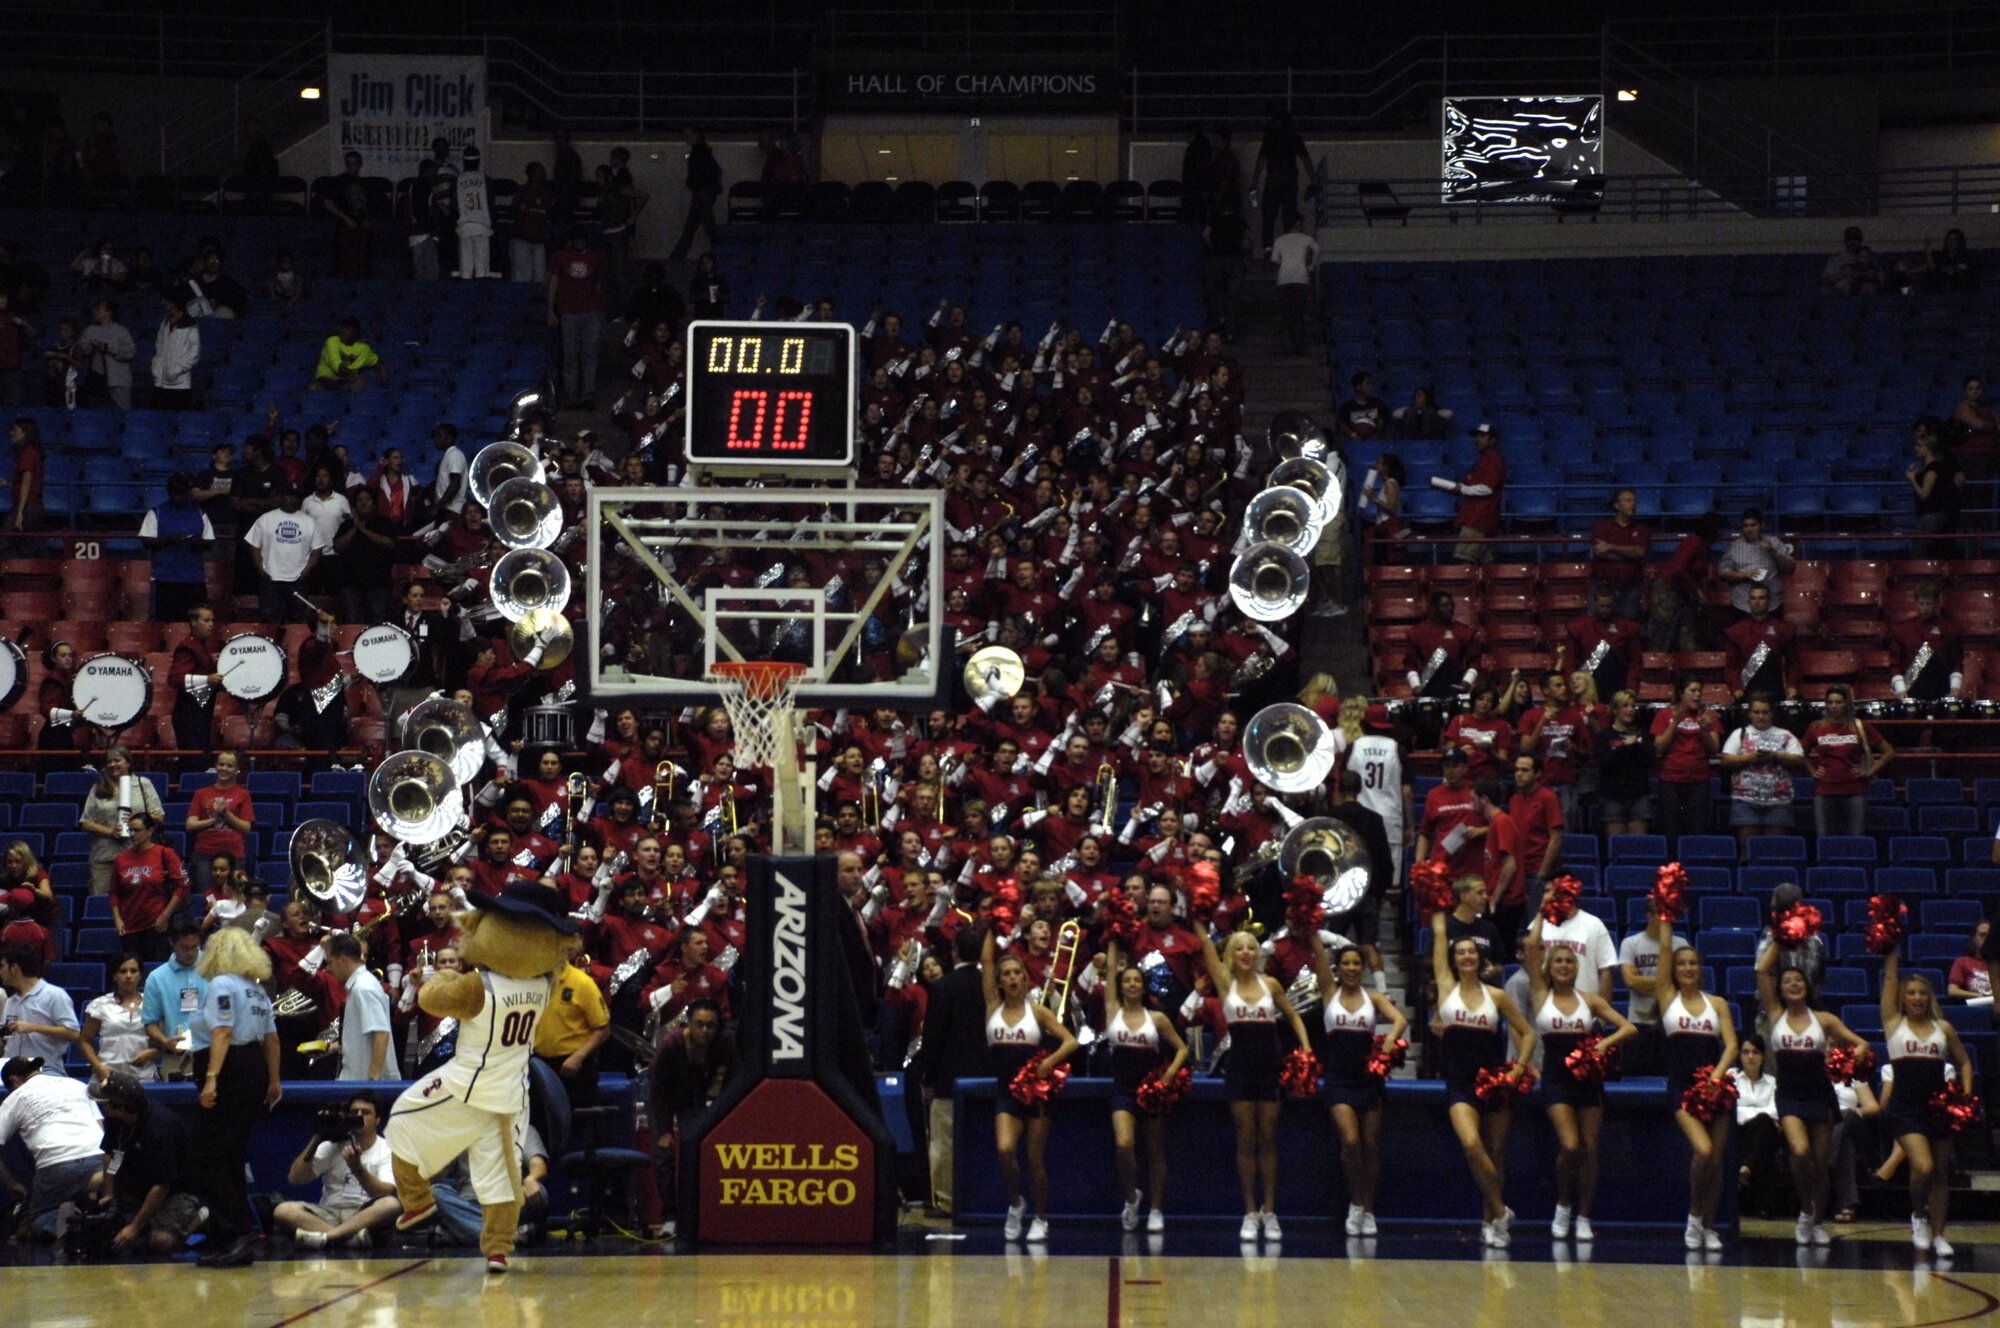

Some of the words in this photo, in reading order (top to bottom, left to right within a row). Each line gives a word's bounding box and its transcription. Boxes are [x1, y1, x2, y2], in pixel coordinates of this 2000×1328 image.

[341, 73, 394, 117] Jim
[405, 73, 474, 118] Click
[848, 75, 907, 94] HALL
[917, 75, 945, 94] OF
[956, 75, 1097, 94] CHAMPIONS
[466, 192, 481, 211] 31
[708, 337, 805, 374] 00.0
[726, 390, 814, 449] 00
[75, 542, 100, 560] 20
[237, 645, 267, 655] YAMAHA
[369, 633, 398, 646] YAMAHA
[98, 666, 133, 677] YAMAHA
[1365, 762, 1384, 790] 31
[772, 870, 807, 1060] ARIZONA
[502, 992, 543, 1008] WILBUR
[501, 1009, 536, 1047] 00
[714, 1143, 860, 1171] WELLS
[719, 1178, 857, 1206] FARGO
